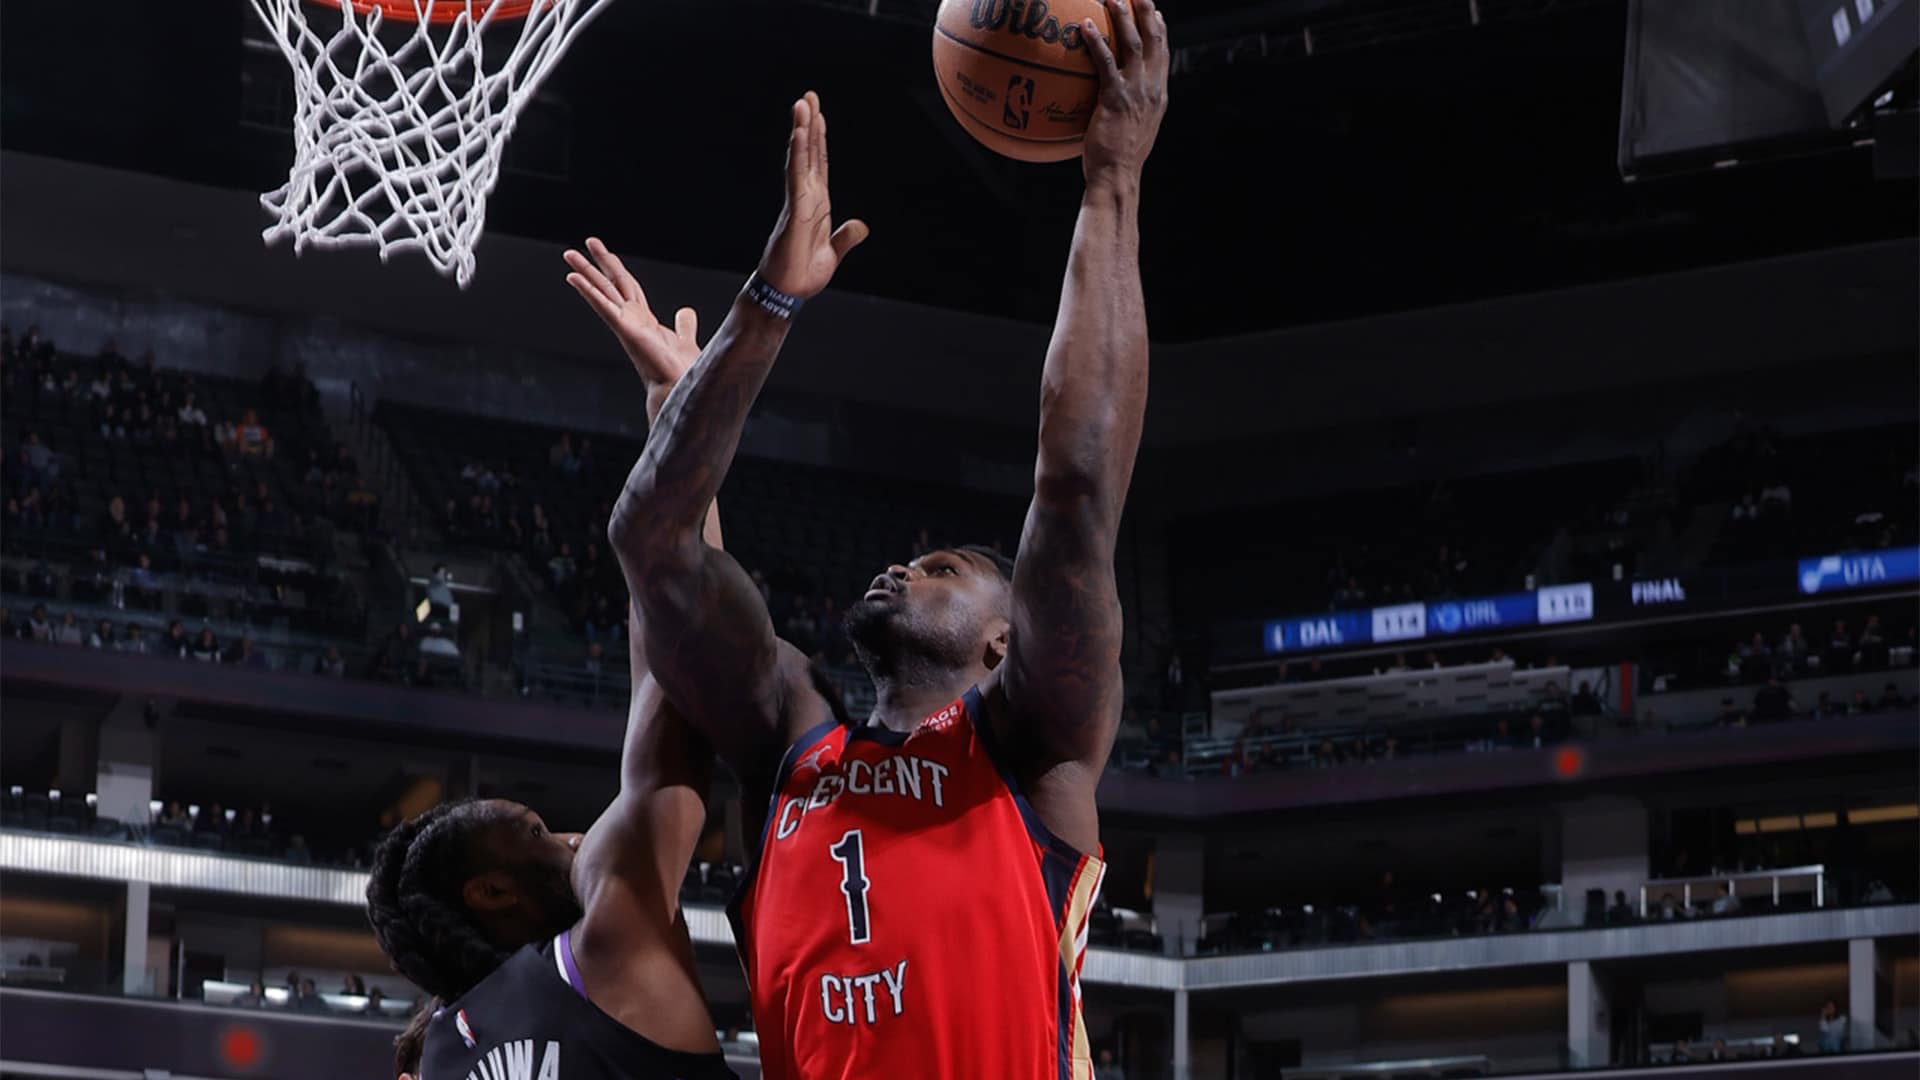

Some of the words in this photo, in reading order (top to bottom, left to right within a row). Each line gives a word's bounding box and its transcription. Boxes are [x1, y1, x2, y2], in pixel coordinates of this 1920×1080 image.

[971, 0, 1108, 50] Wilso
[1843, 556, 1886, 587] UTA
[1300, 617, 1345, 648] DAL
[1631, 577, 1686, 606] FINAL
[777, 754, 949, 841] CECENT
[829, 828, 871, 945] 1
[820, 959, 909, 1025] CITY
